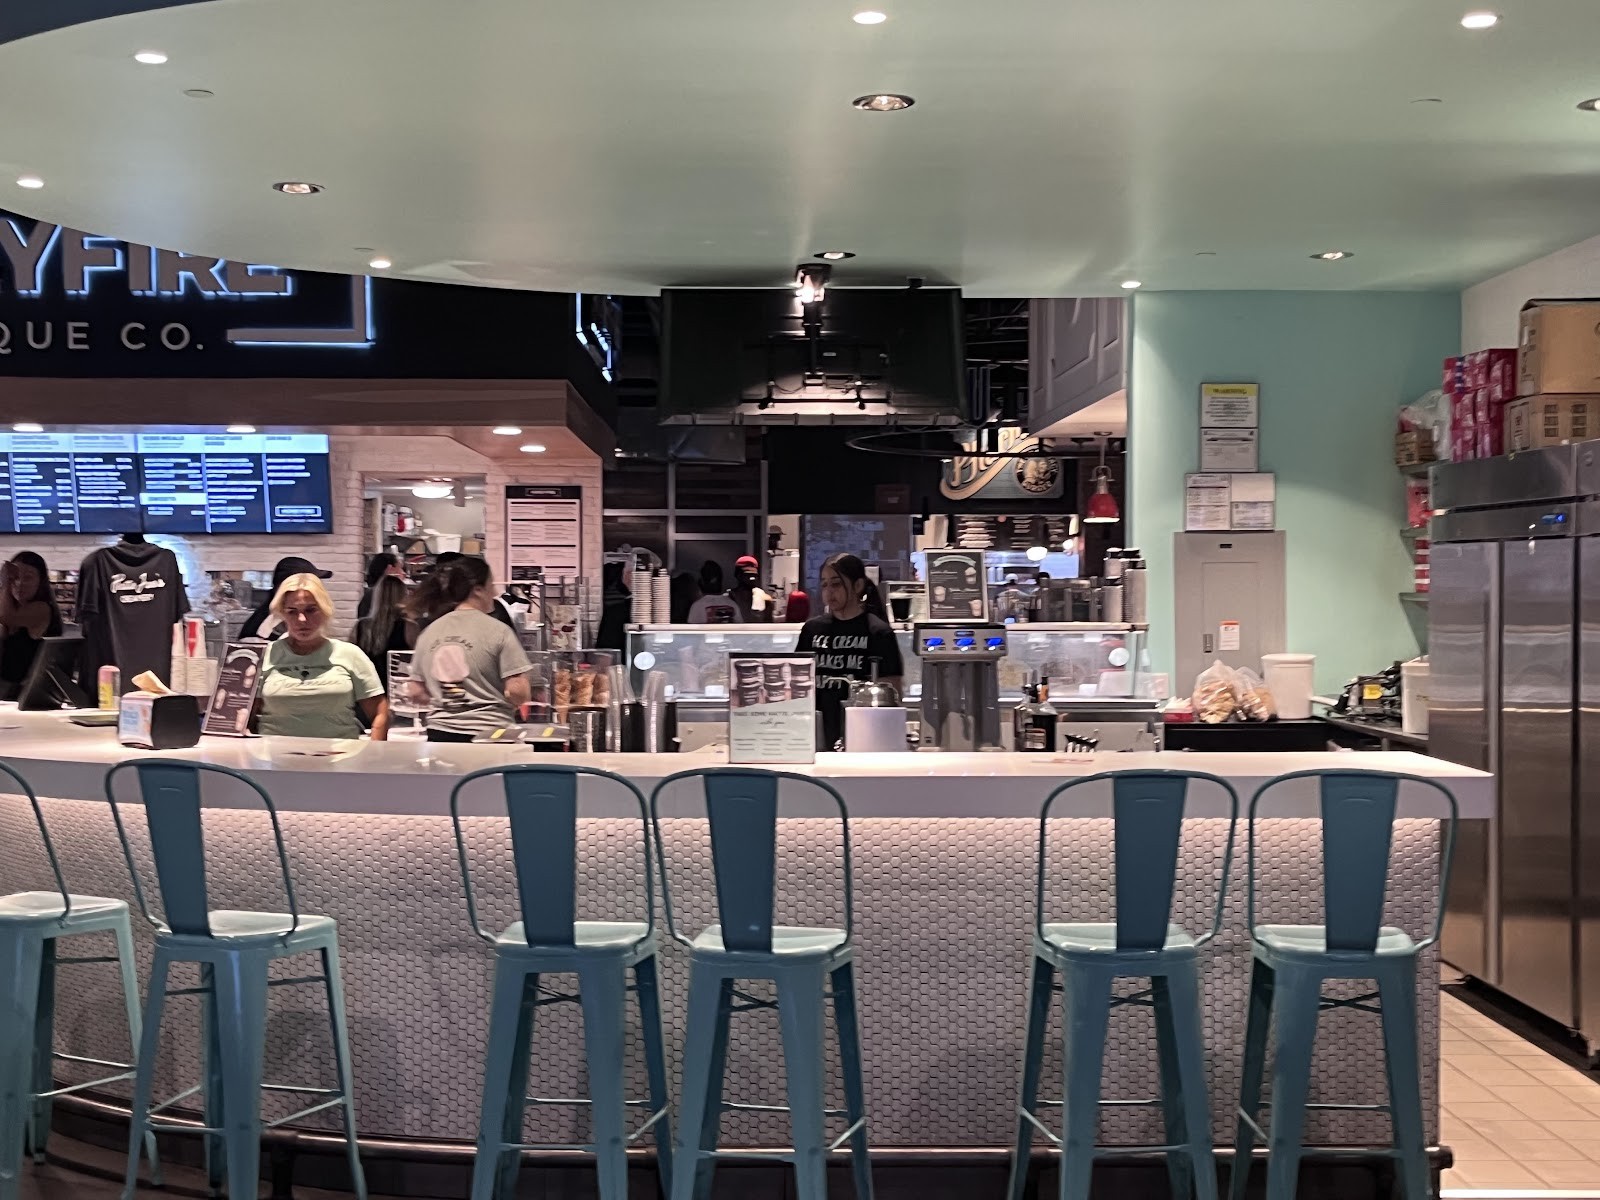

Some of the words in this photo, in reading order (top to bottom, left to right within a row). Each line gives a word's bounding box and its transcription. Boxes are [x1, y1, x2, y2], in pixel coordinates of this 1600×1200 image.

[120, 321, 204, 351] CO.
[812, 635, 830, 648] ICE
[832, 635, 868, 649] CREAM
[847, 655, 864, 669] ME
